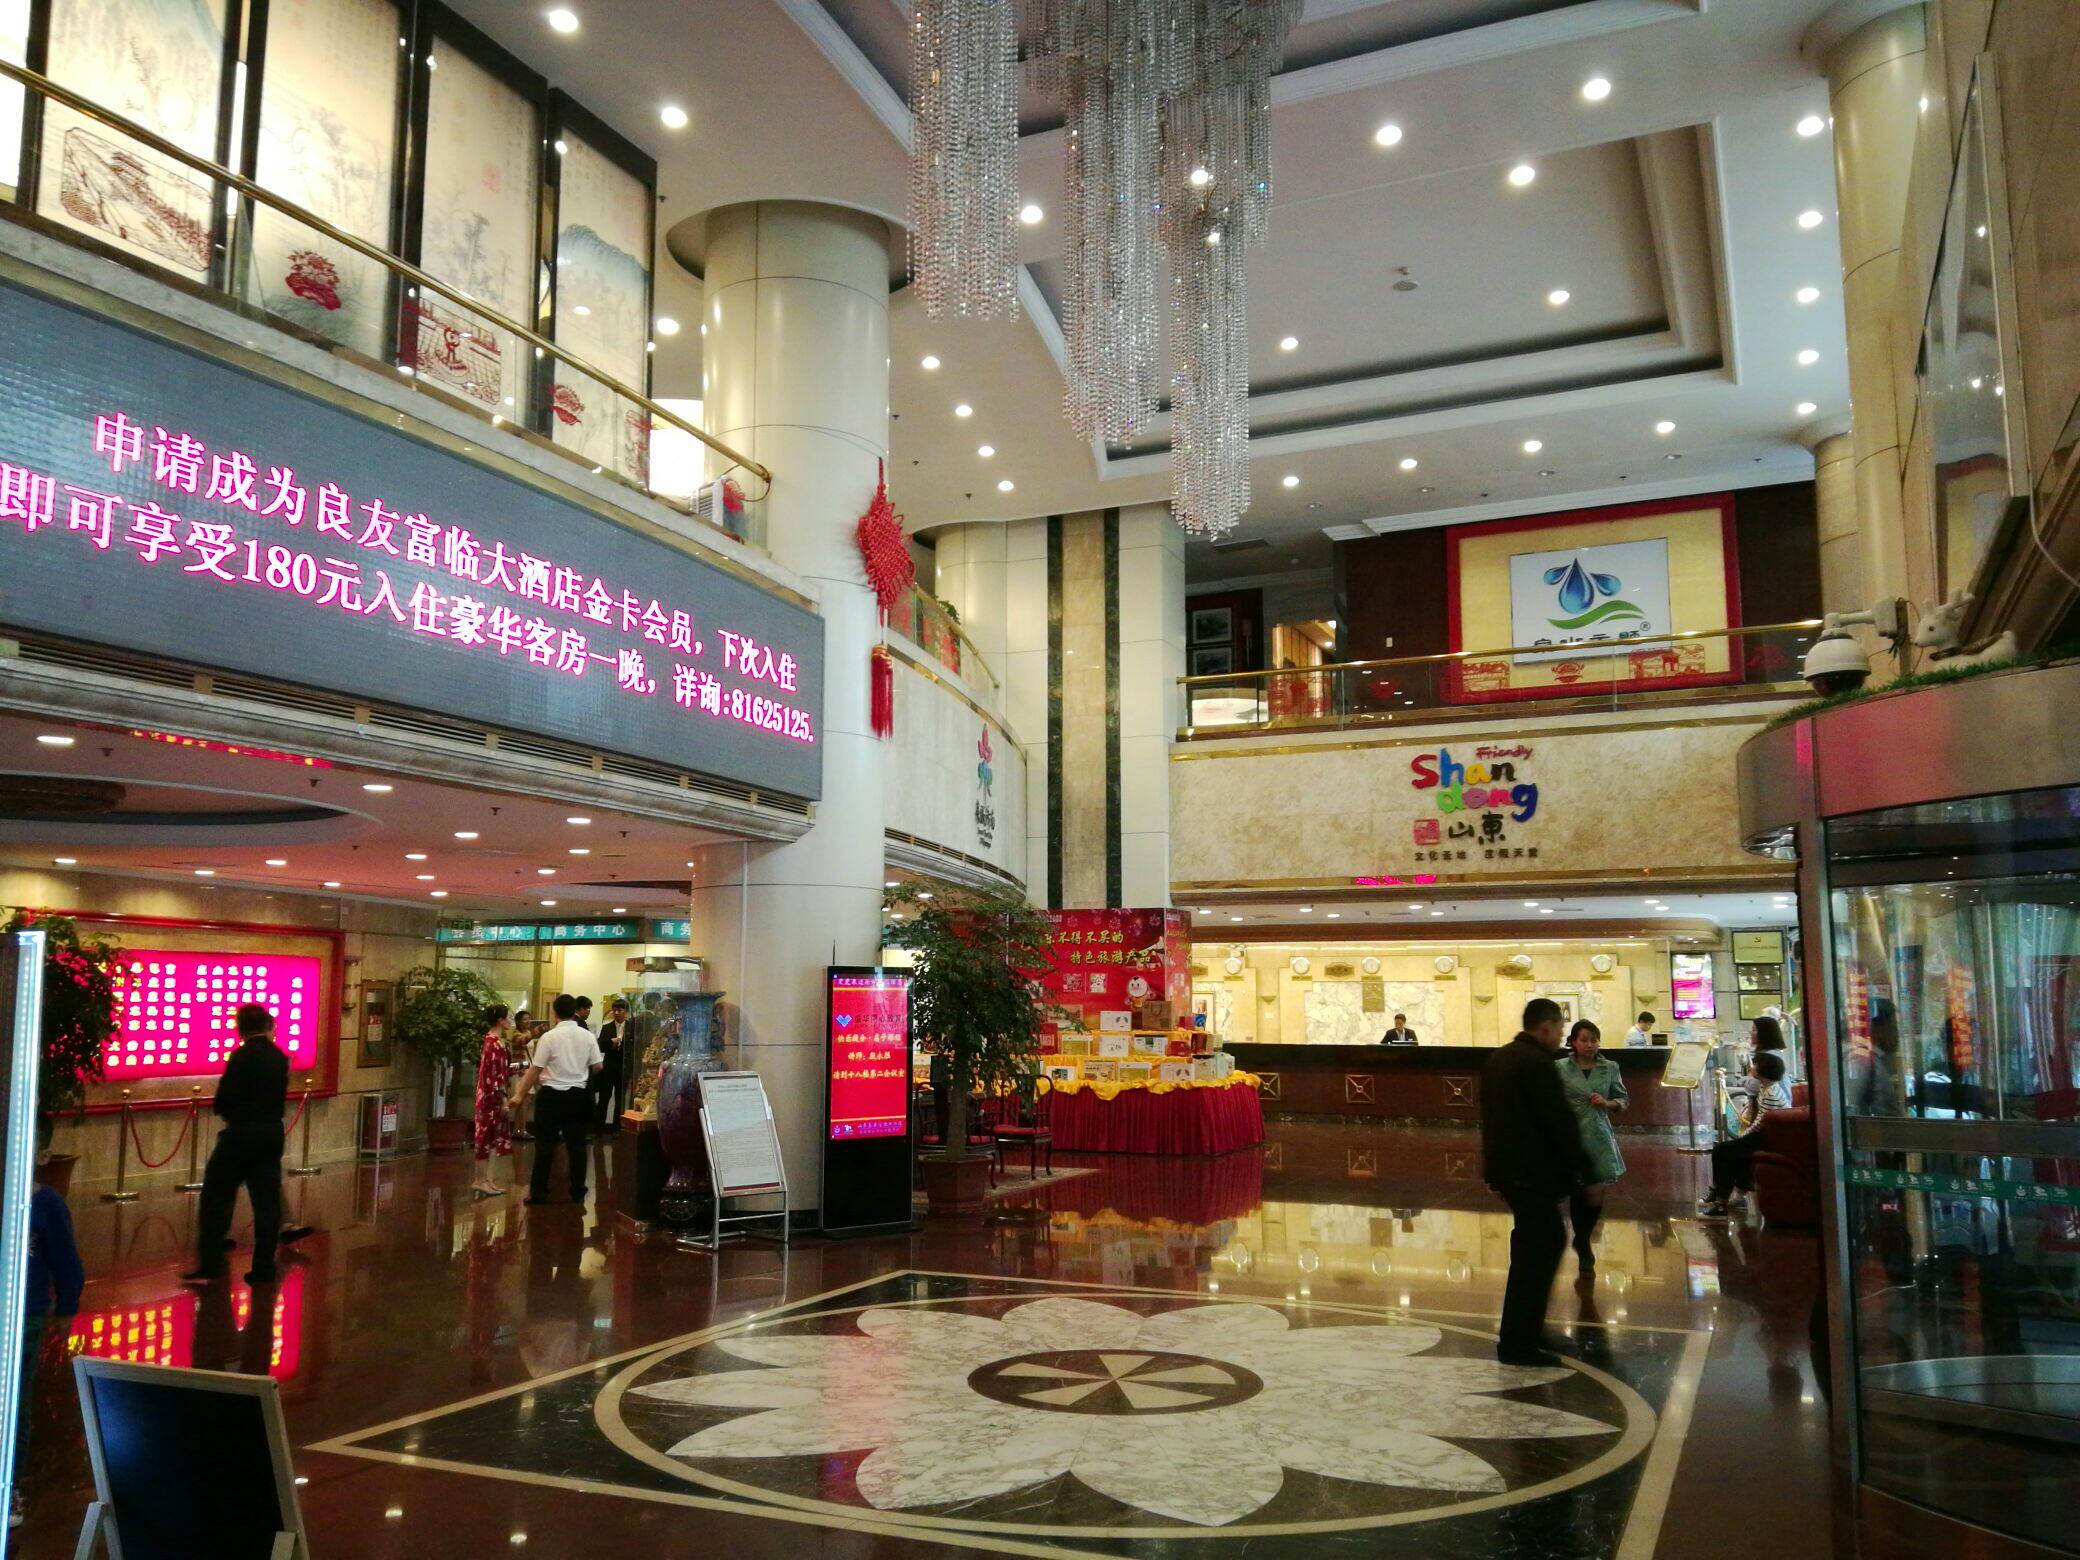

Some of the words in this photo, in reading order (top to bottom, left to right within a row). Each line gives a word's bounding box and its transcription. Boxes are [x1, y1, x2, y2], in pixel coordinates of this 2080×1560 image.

[1475, 745, 1533, 760] Friendly
[1411, 748, 1516, 789] Shan
[1436, 782, 1538, 823] dong
[554, 925, 625, 937] 商务中心
